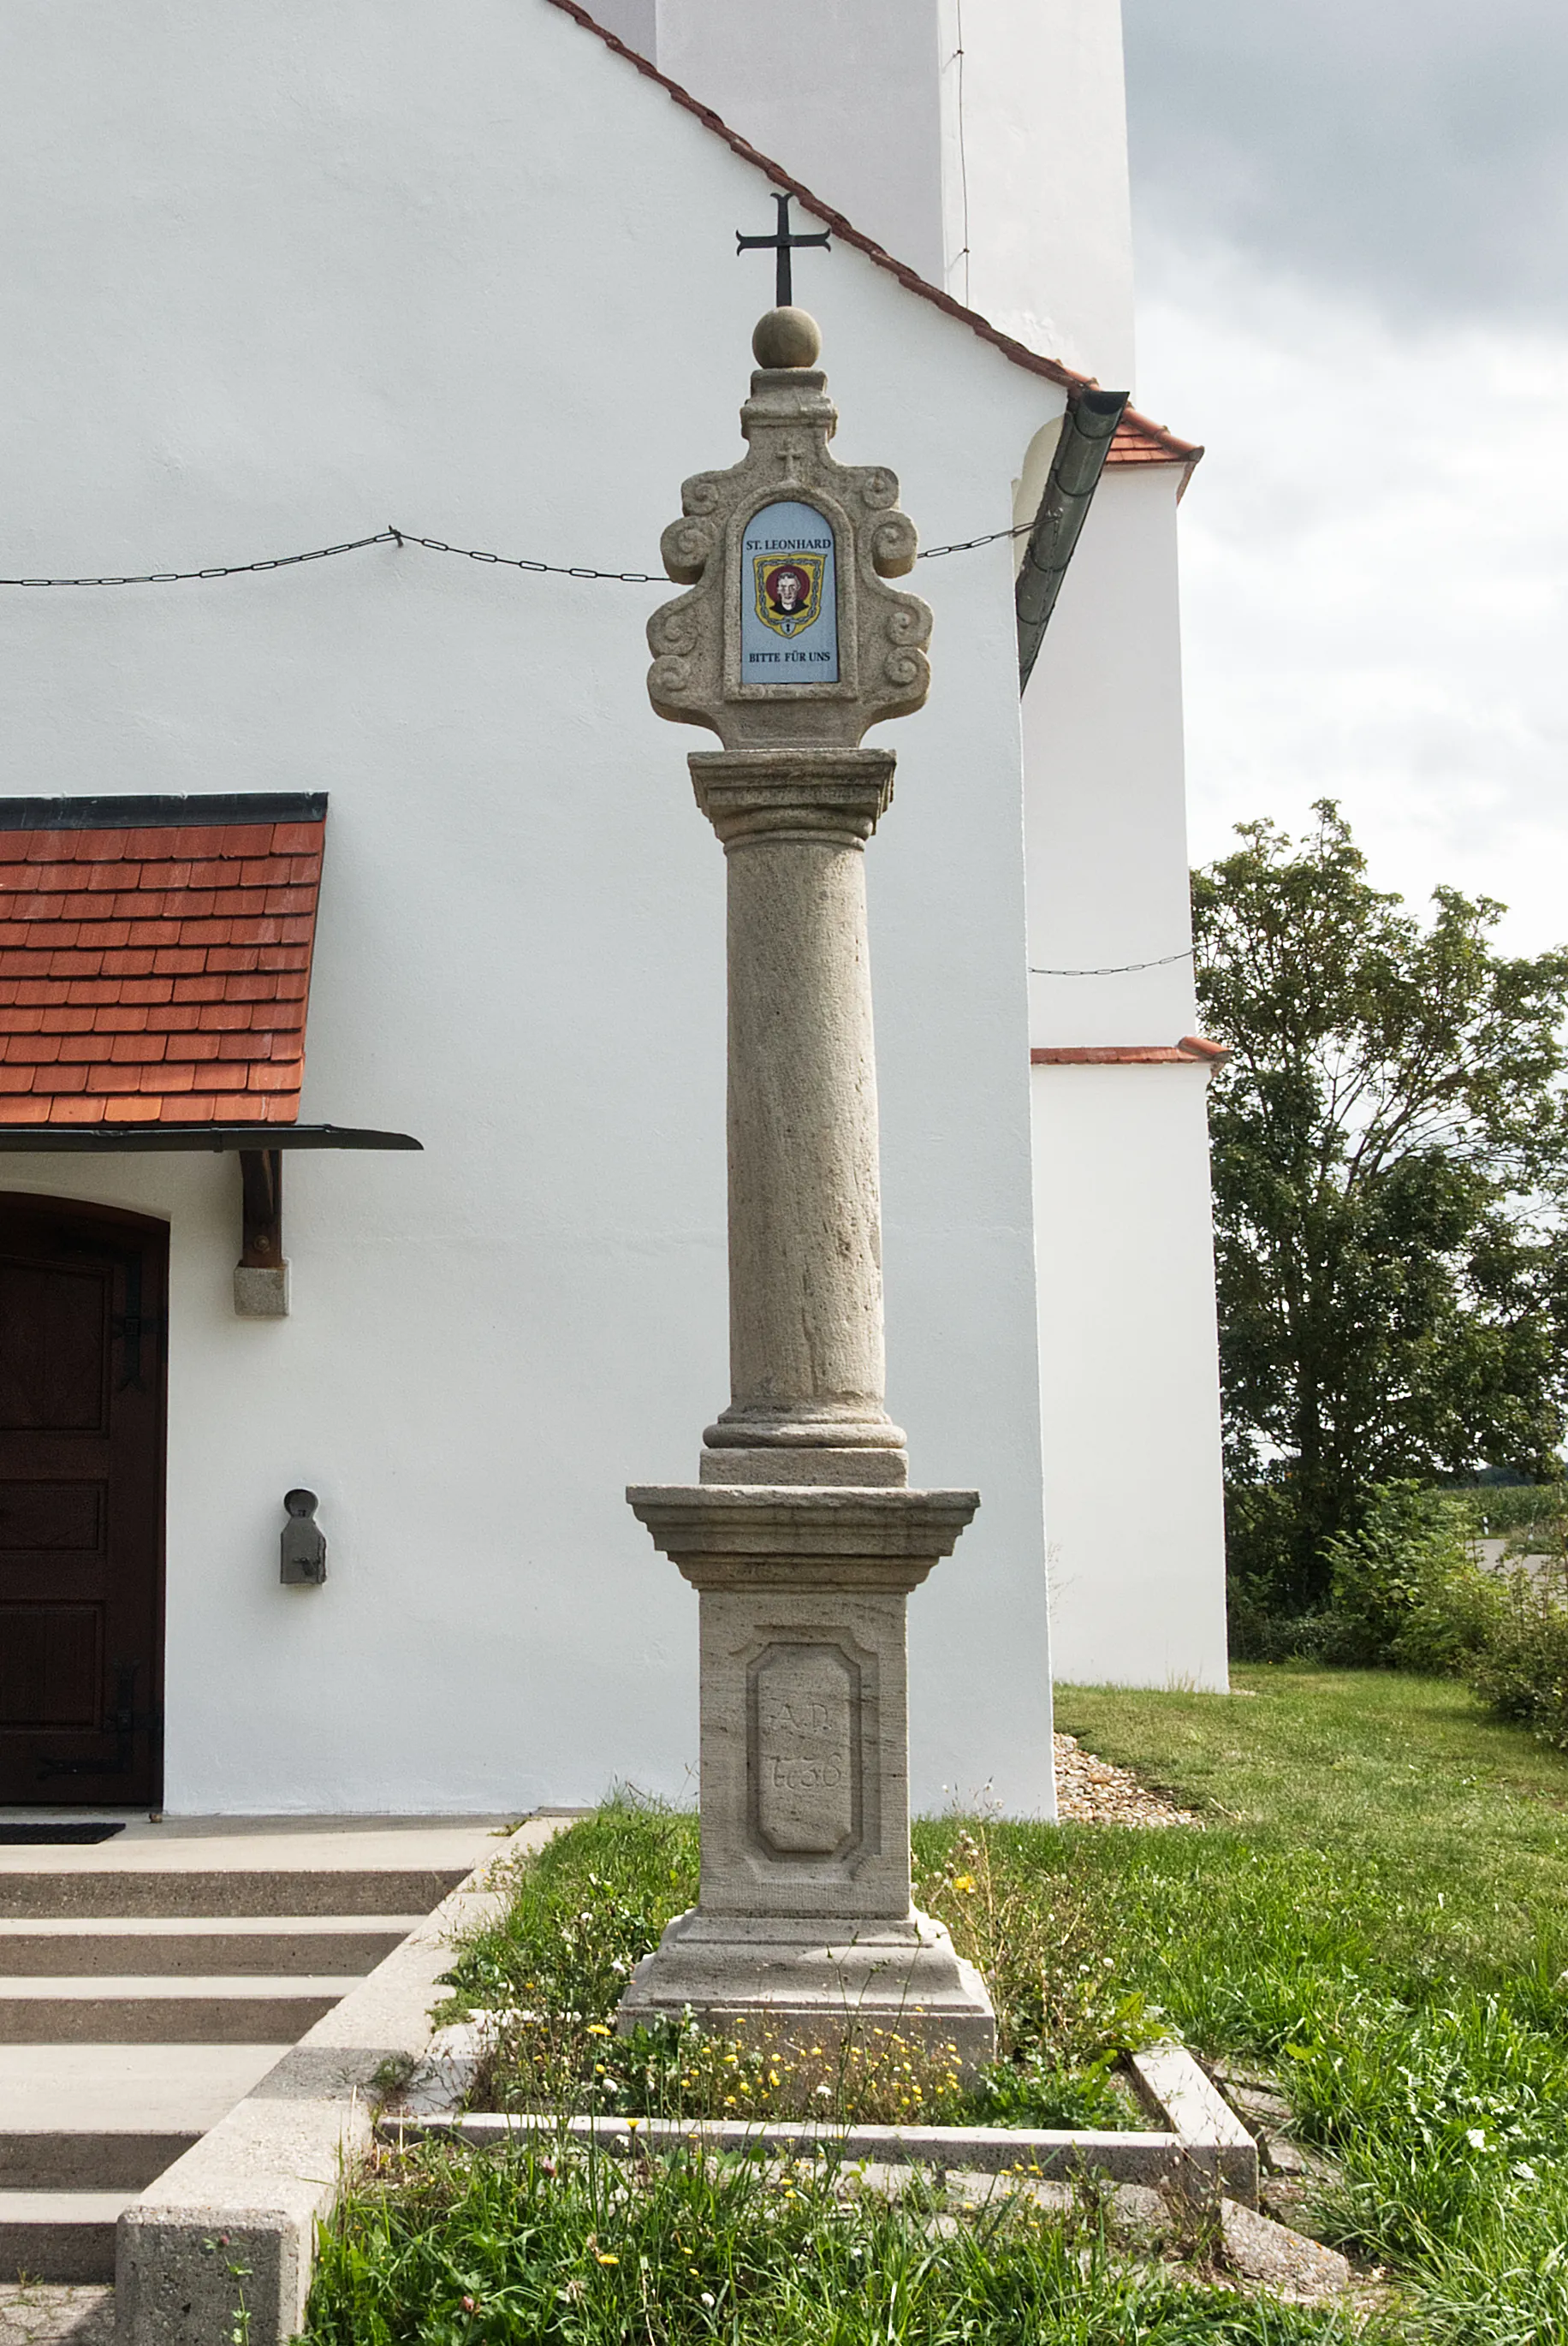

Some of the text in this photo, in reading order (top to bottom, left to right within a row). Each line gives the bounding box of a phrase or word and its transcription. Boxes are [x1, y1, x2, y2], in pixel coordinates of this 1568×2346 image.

[746, 539, 831, 550] ST. LEONHARD
[749, 650, 831, 662] BITTE FÜR UNS
